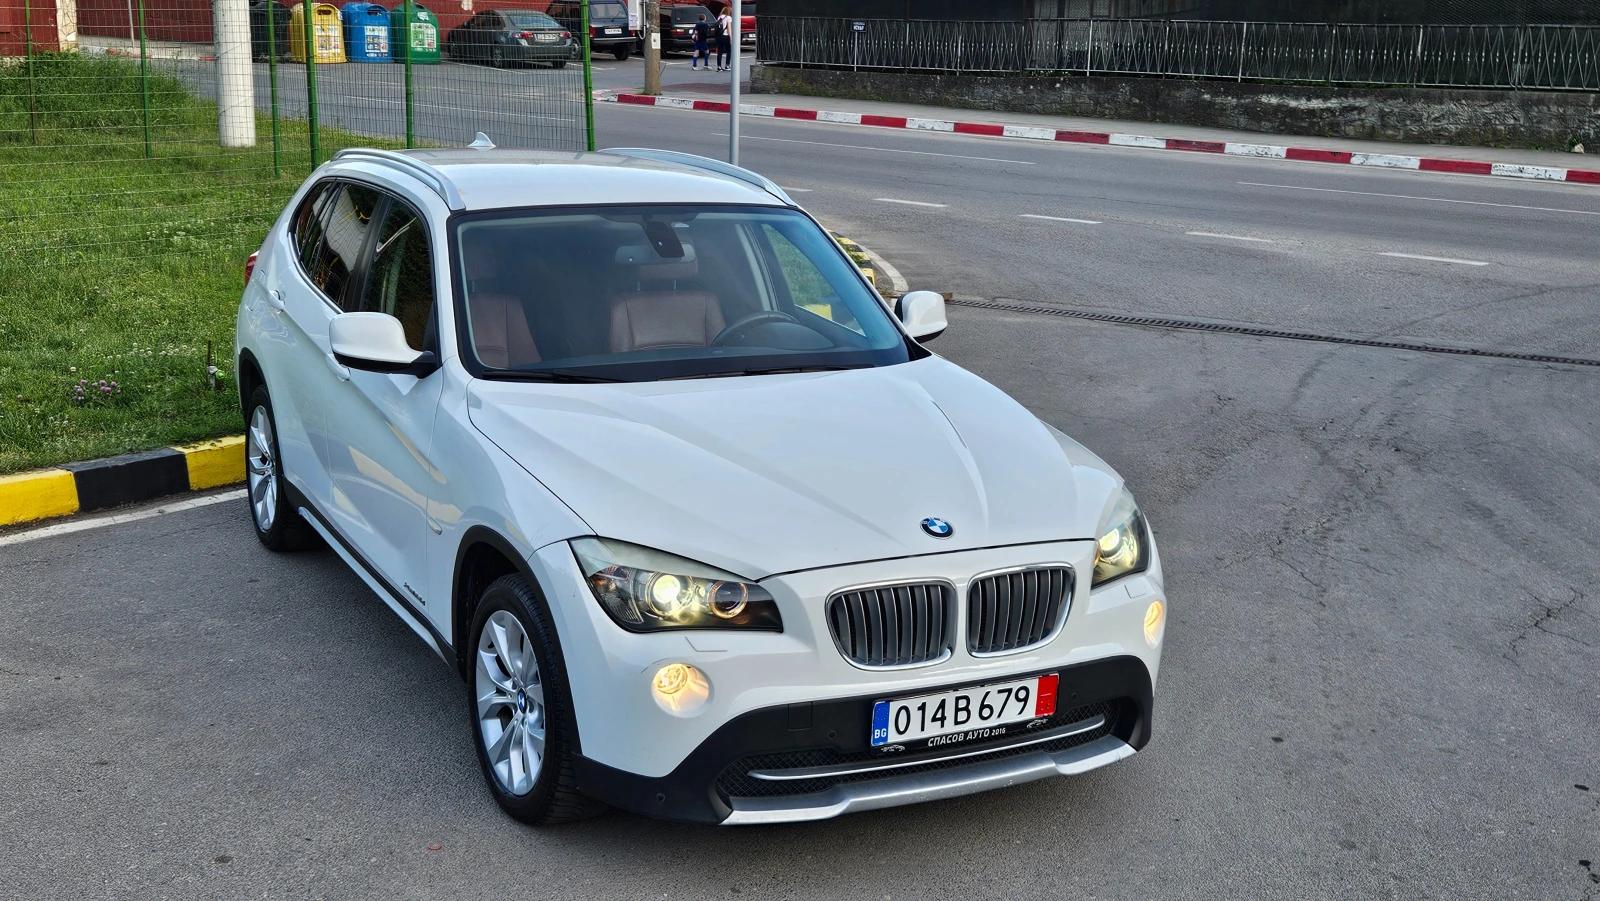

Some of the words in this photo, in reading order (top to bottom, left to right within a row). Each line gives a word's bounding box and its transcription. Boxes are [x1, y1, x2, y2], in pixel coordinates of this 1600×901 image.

[874, 728, 886, 739] BG
[928, 733, 964, 747] СПАСОВ
[967, 728, 989, 740] АУТО
[992, 727, 1006, 736] 2016
